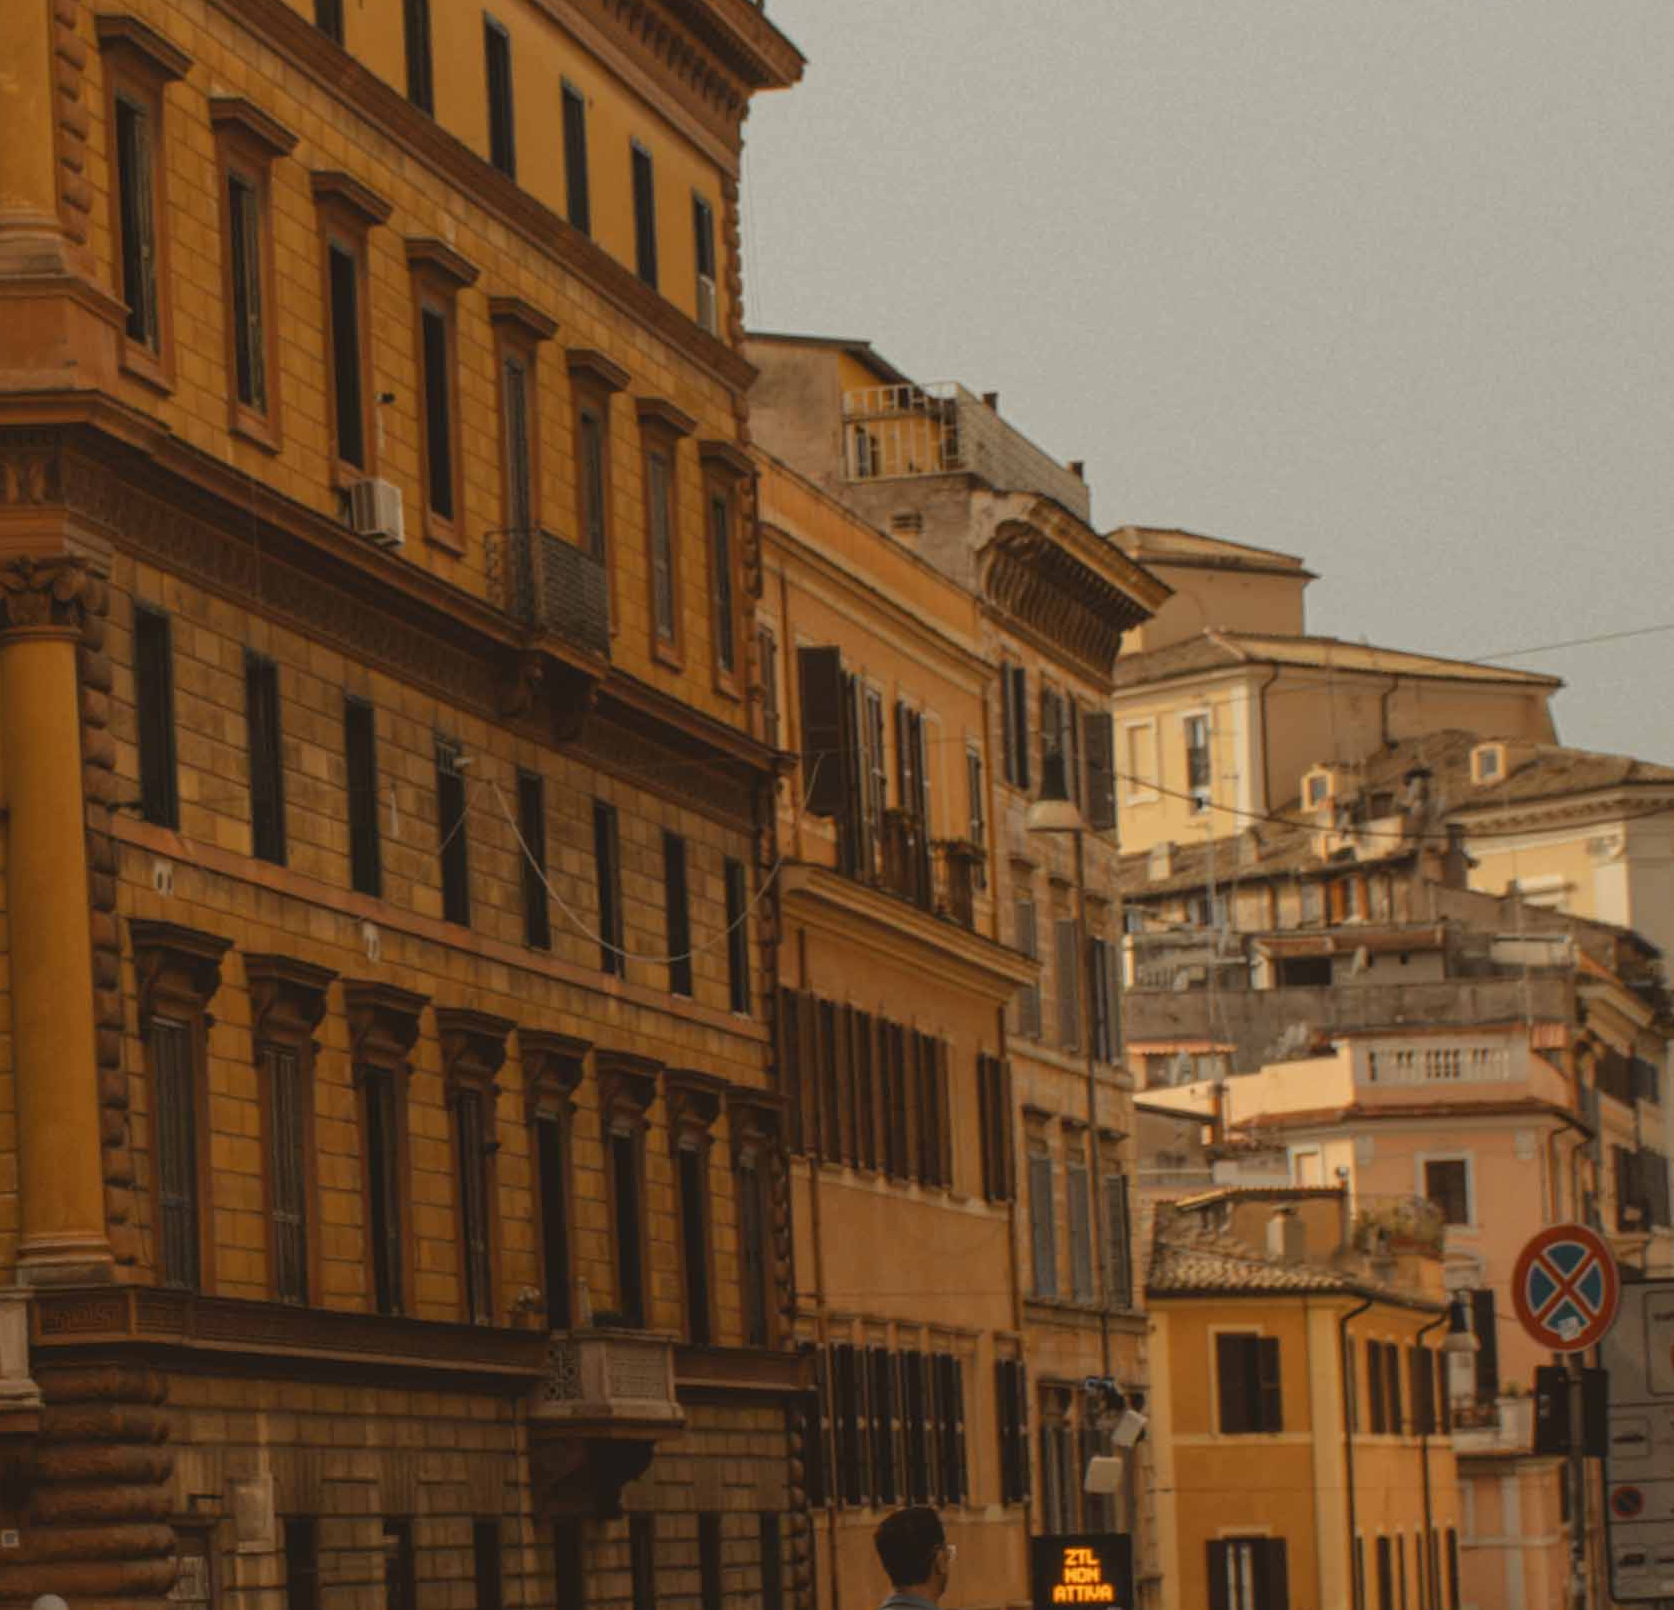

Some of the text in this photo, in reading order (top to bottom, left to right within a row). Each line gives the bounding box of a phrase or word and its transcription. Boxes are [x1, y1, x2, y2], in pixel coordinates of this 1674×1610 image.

[1063, 1548, 1100, 1566] ZTL
[1063, 1567, 1100, 1583] NON
[1053, 1584, 1114, 1603] ATTIVA
